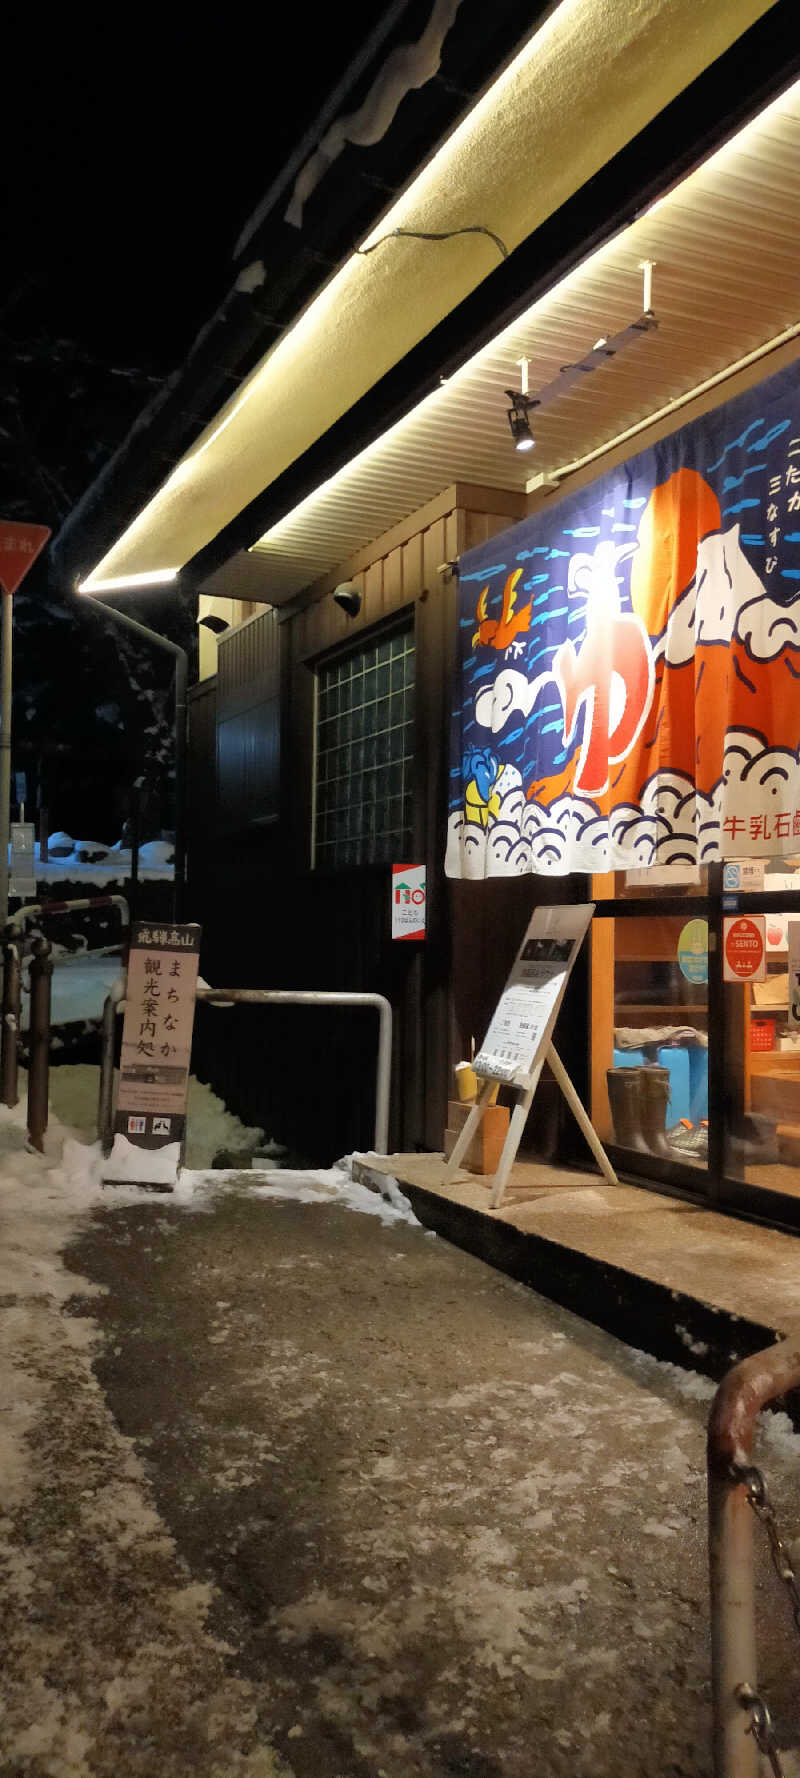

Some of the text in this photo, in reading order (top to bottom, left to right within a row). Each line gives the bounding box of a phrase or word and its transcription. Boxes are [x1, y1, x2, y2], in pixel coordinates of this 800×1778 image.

[765, 474, 782, 574] 三なすび
[553, 607, 656, 797] ゆ
[735, 940, 759, 948] SENTO
[136, 957, 163, 1058] 観光案内処
[160, 960, 182, 1057] まちなか
